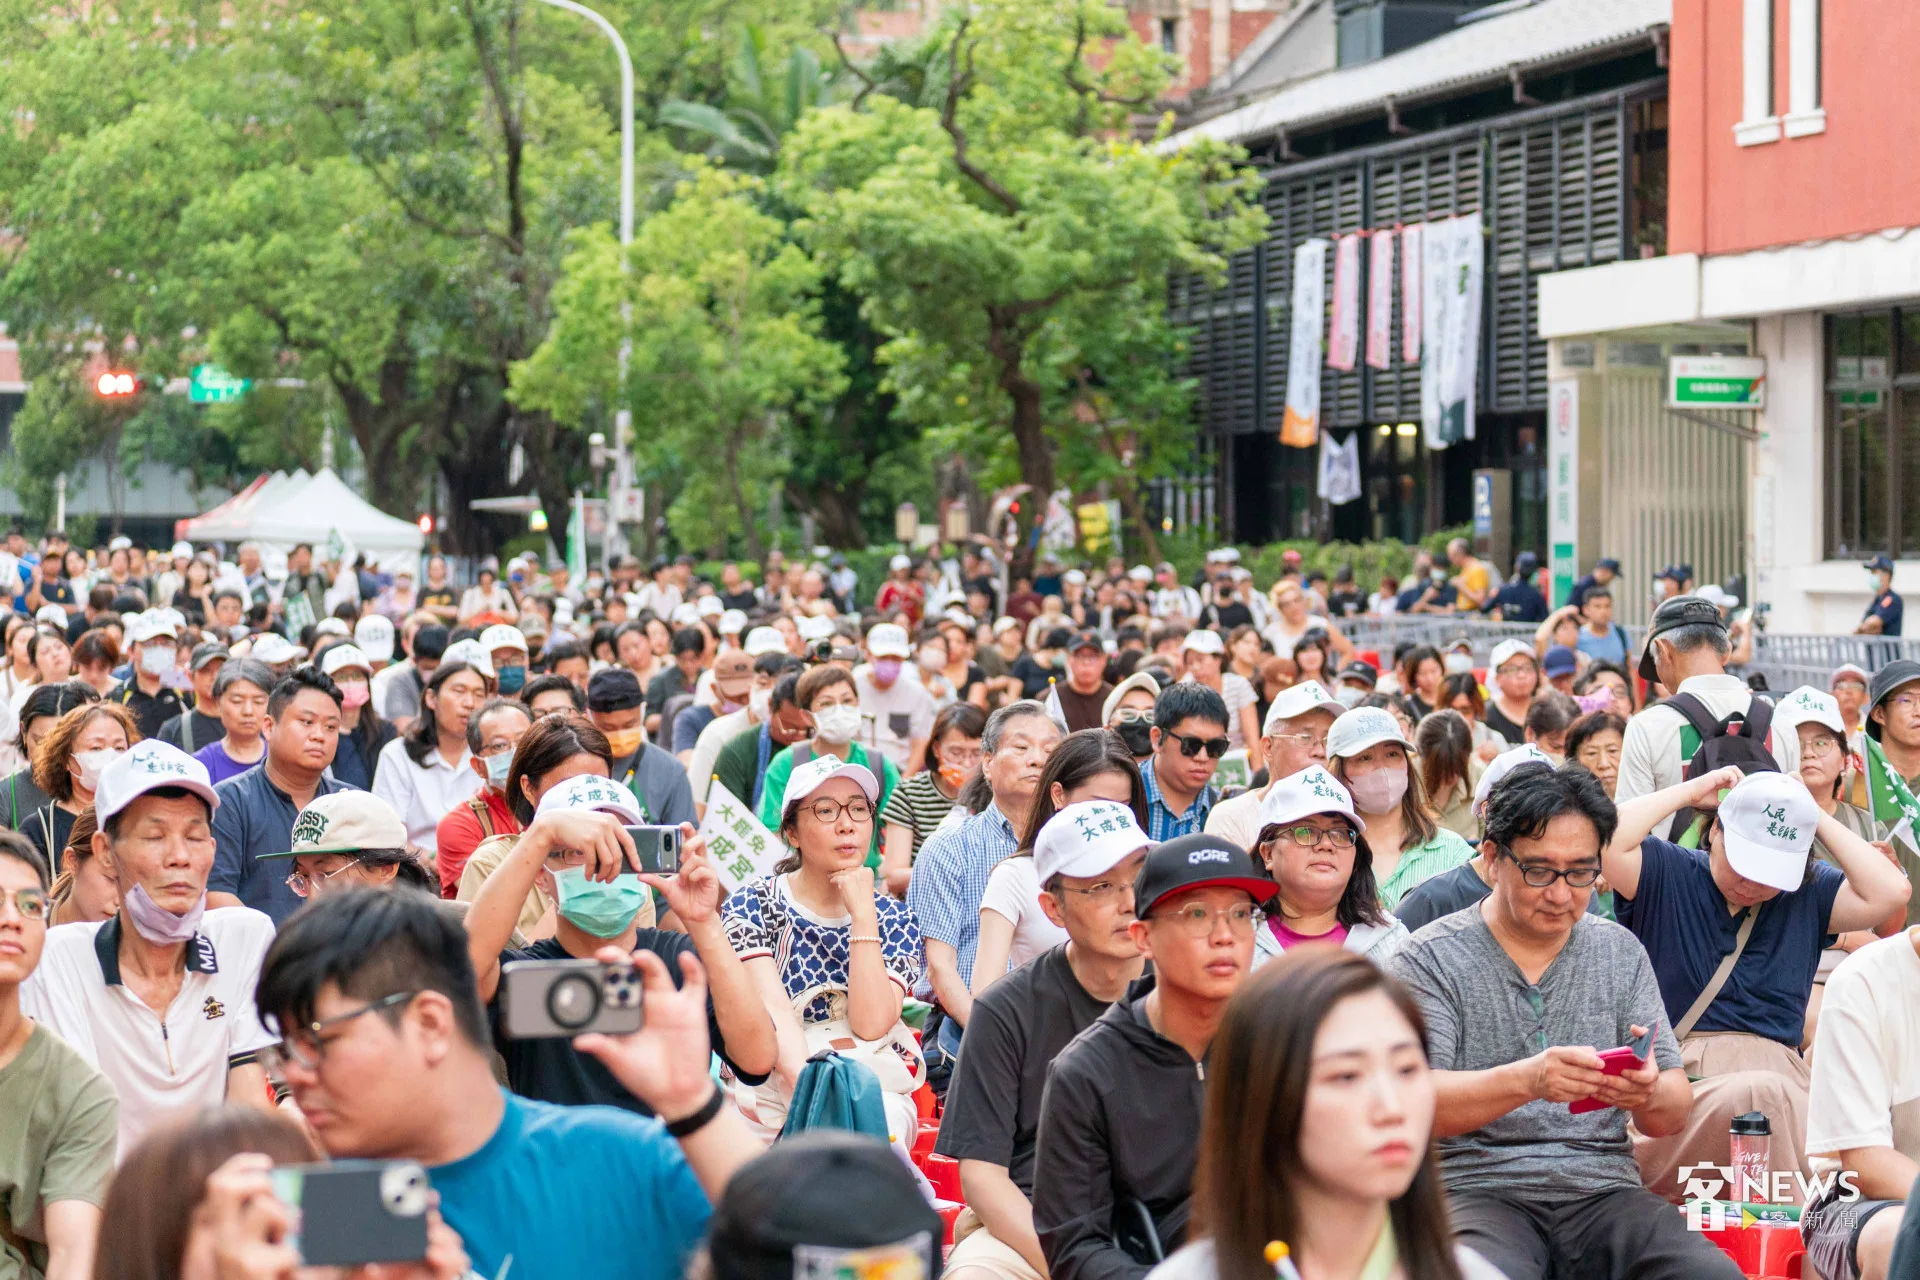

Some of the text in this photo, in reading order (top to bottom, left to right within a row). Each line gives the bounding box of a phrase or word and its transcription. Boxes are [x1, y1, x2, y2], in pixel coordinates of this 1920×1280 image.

[1302, 772, 1326, 784] 人民
[1761, 804, 1786, 823] 人民
[715, 803, 766, 855] 大罷免
[1082, 815, 1131, 841] 大成宮
[1766, 821, 1798, 840] 是頭家
[707, 829, 755, 881] 成宮
[1188, 849, 1230, 864] QORE
